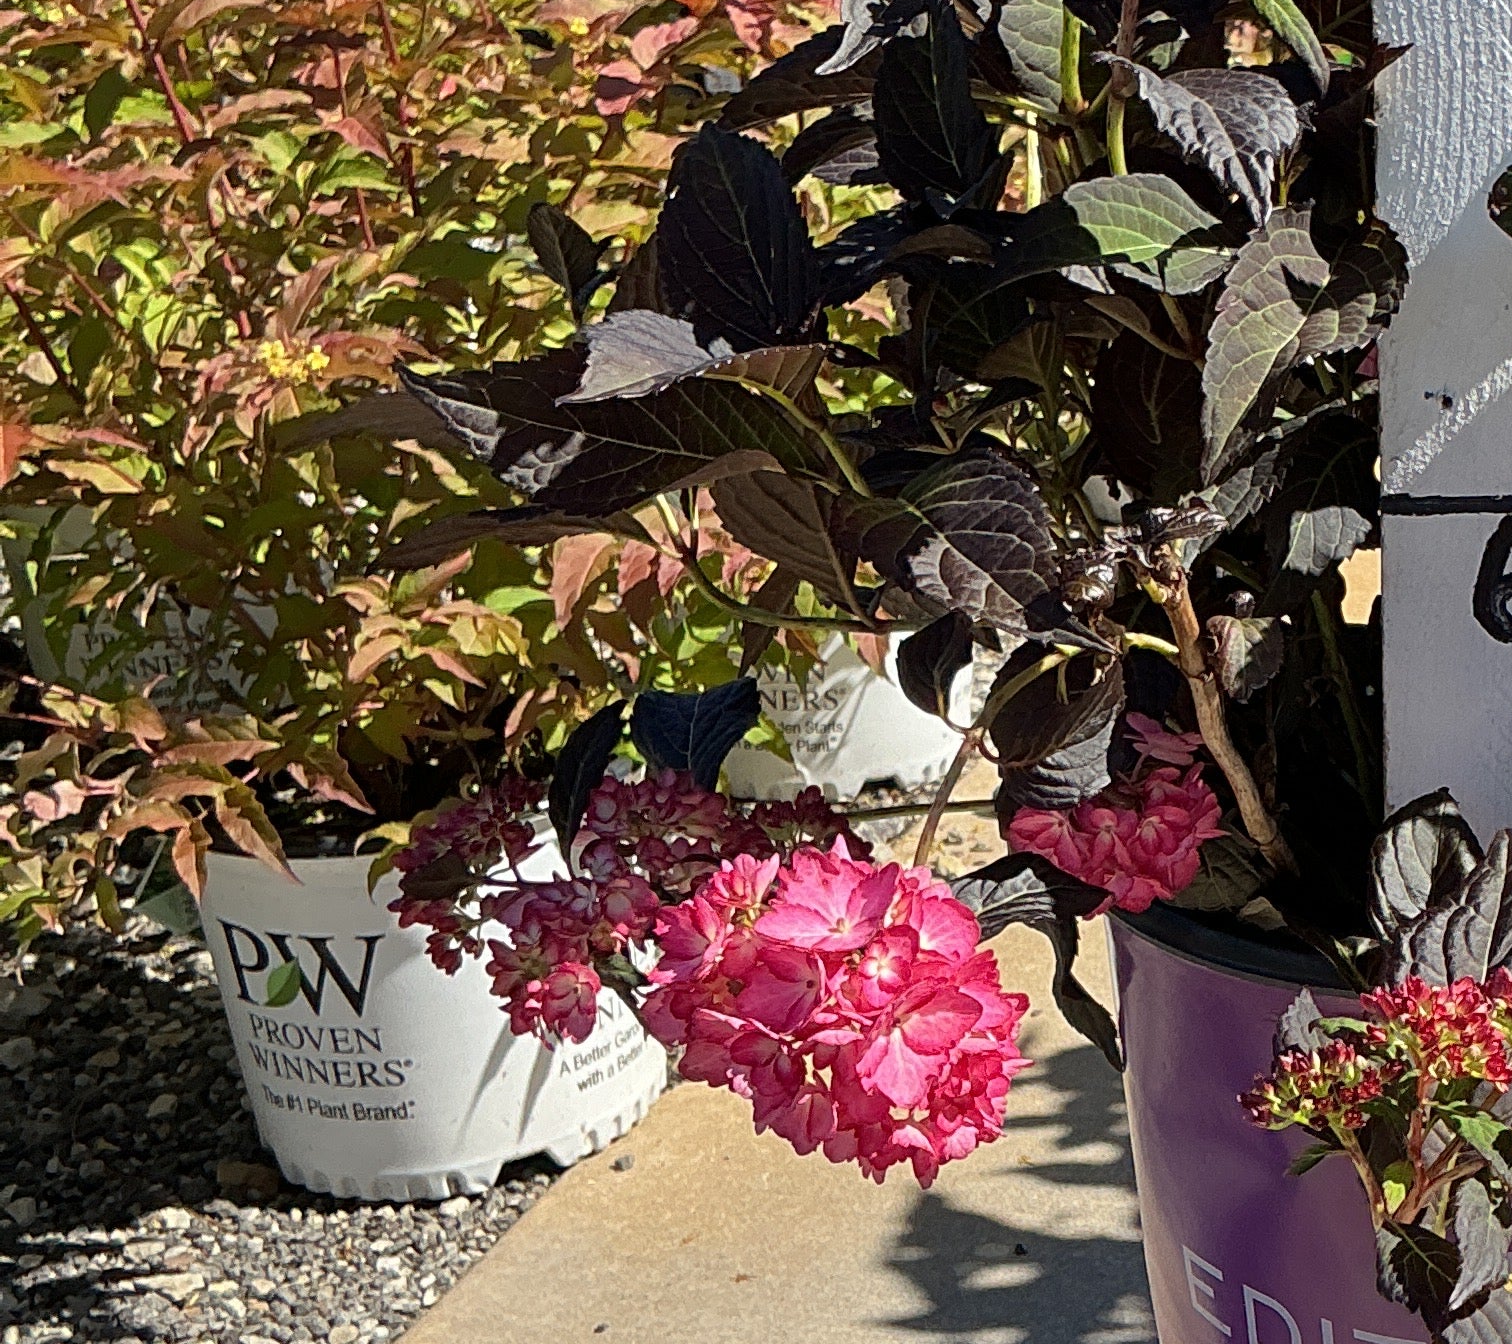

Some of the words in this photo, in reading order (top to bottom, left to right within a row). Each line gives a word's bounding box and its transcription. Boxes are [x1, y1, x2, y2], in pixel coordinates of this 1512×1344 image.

[757, 689, 838, 711] NERS
[250, 1013, 383, 1055] PROVEN
[573, 1042, 611, 1071] Better
[577, 1070, 604, 1092] with
[262, 1083, 284, 1108] The
[307, 1097, 348, 1121] Plant
